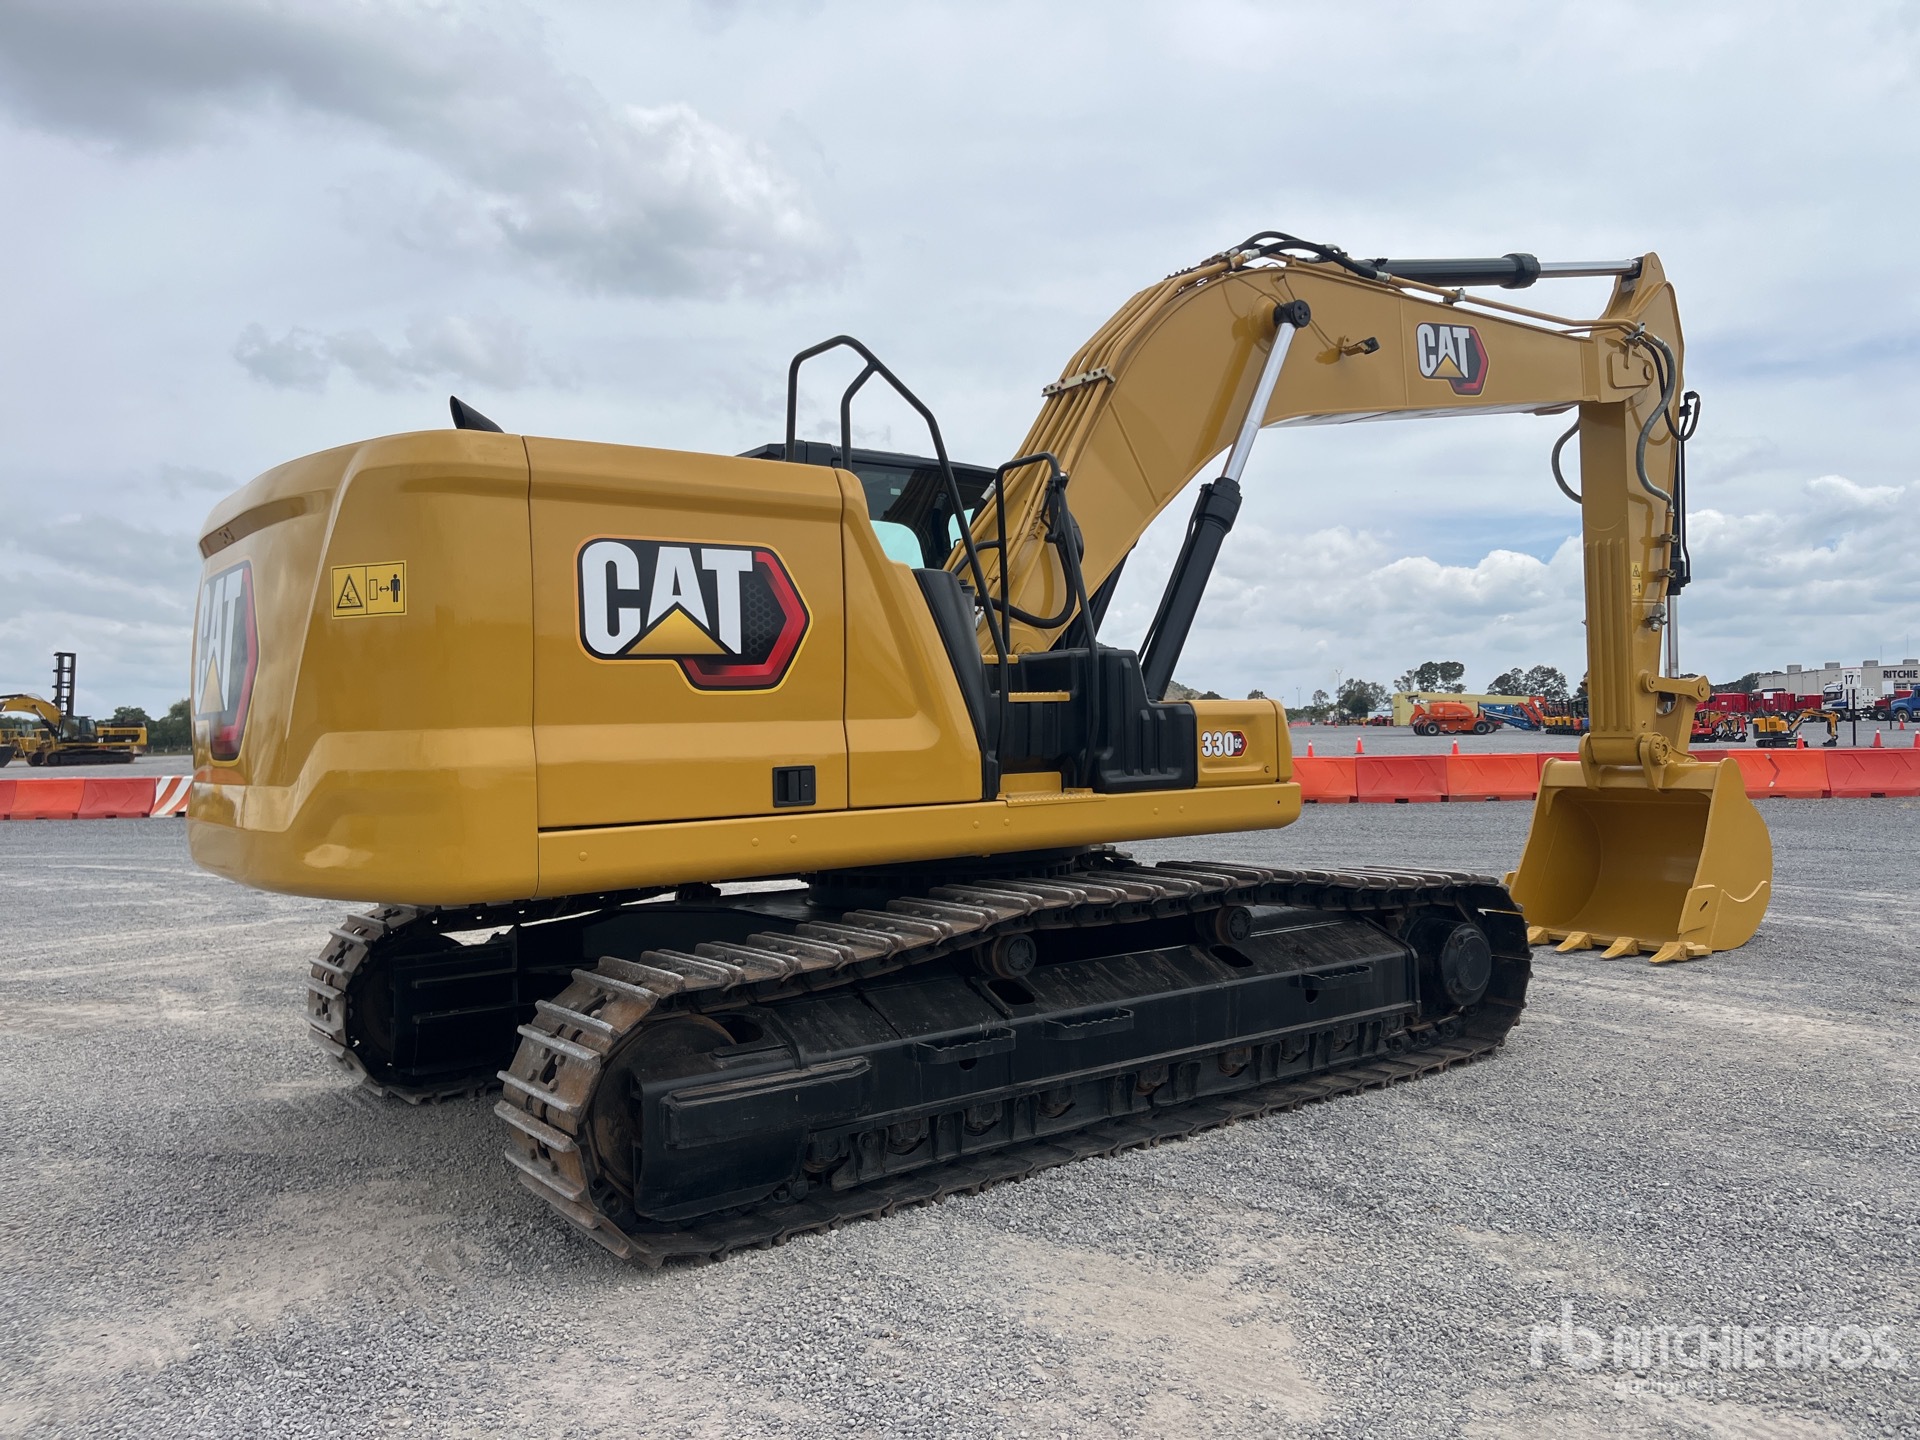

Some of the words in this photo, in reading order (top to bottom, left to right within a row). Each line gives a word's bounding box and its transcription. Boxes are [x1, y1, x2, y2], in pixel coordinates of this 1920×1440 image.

[1417, 324, 1470, 379] CAT
[582, 541, 753, 655] CAT
[195, 568, 243, 715] CAT
[1844, 674, 1854, 684] 17
[1883, 670, 1918, 678] RITCHIE
[1202, 732, 1234, 756] 330
